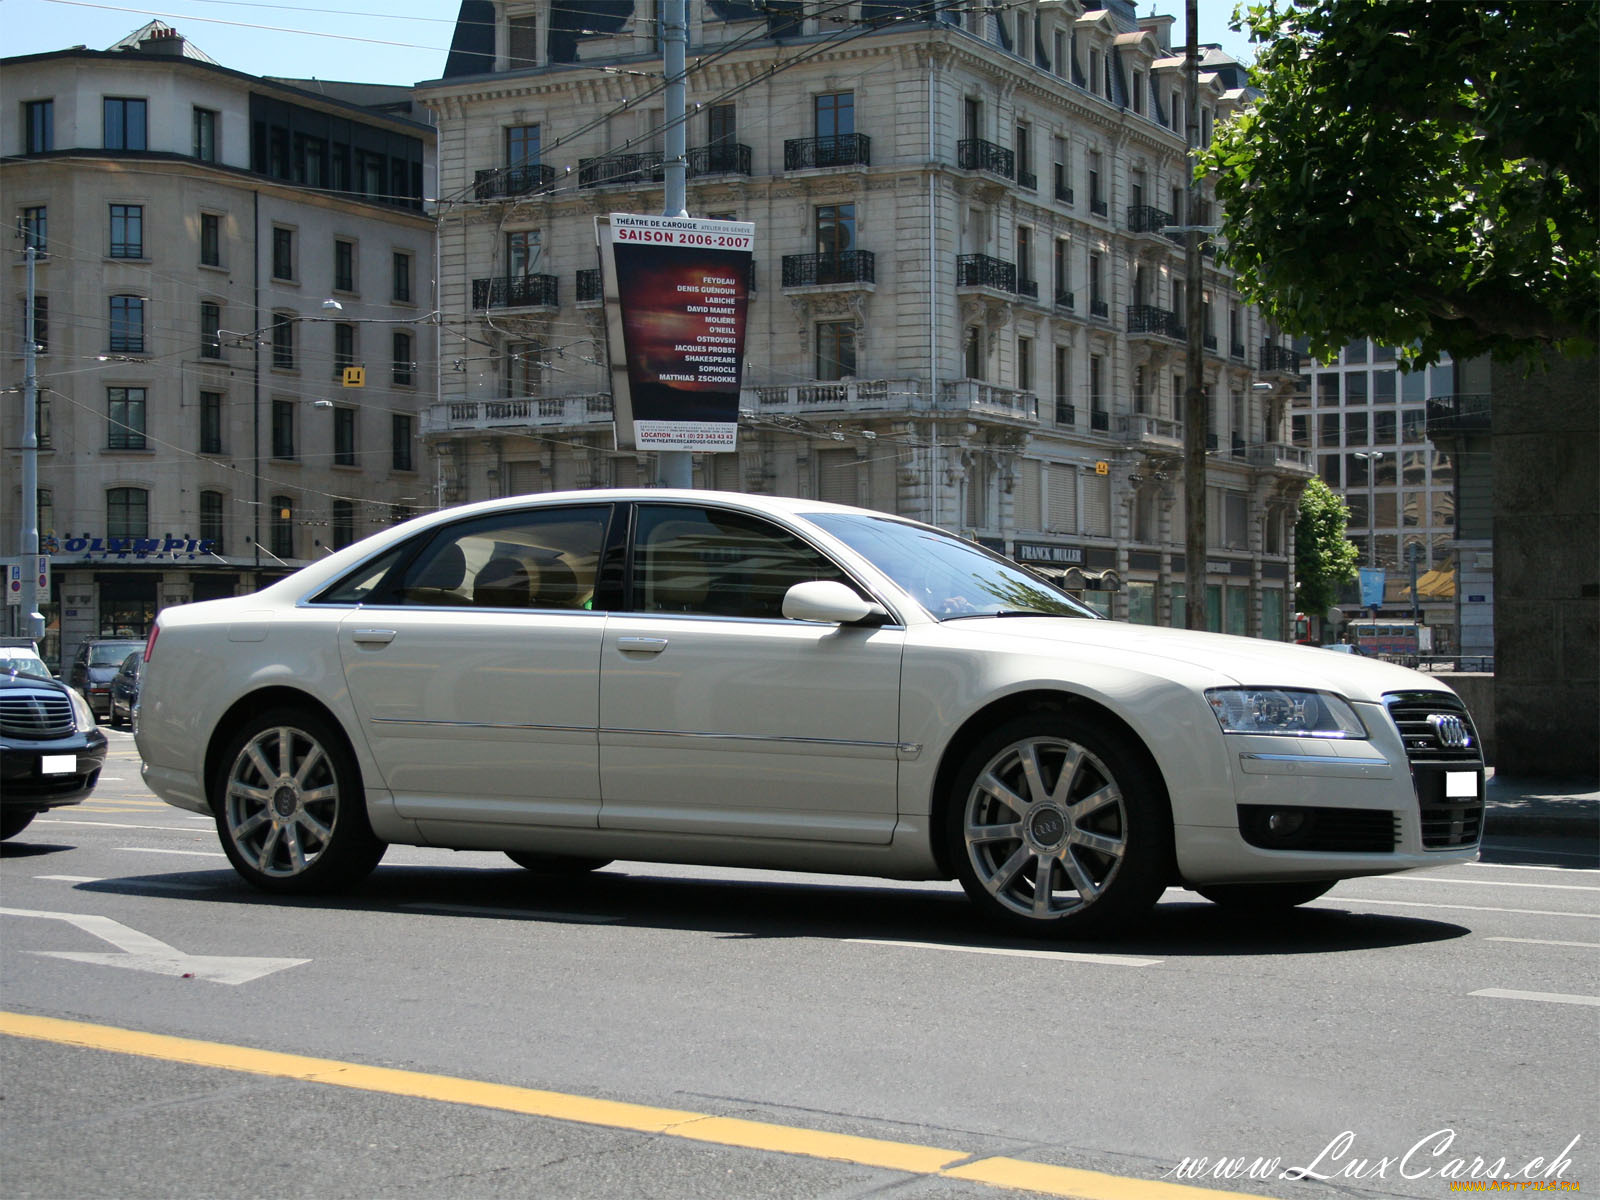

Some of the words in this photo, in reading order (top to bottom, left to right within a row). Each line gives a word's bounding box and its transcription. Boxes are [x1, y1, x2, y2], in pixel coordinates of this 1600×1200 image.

[662, 221, 697, 230] CAROUGE
[618, 228, 673, 243] SAISON
[679, 233, 750, 248] 2006-2007
[703, 276, 735, 285] FEYDEAU
[705, 296, 735, 304] LABICHE
[684, 355, 736, 363] SHAKESPEARE
[65, 538, 216, 554] OLYMPIC
[84, 552, 196, 560] AIRWAYS
[1022, 545, 1051, 560] FRANCK
[1053, 548, 1081, 563] MULLER
